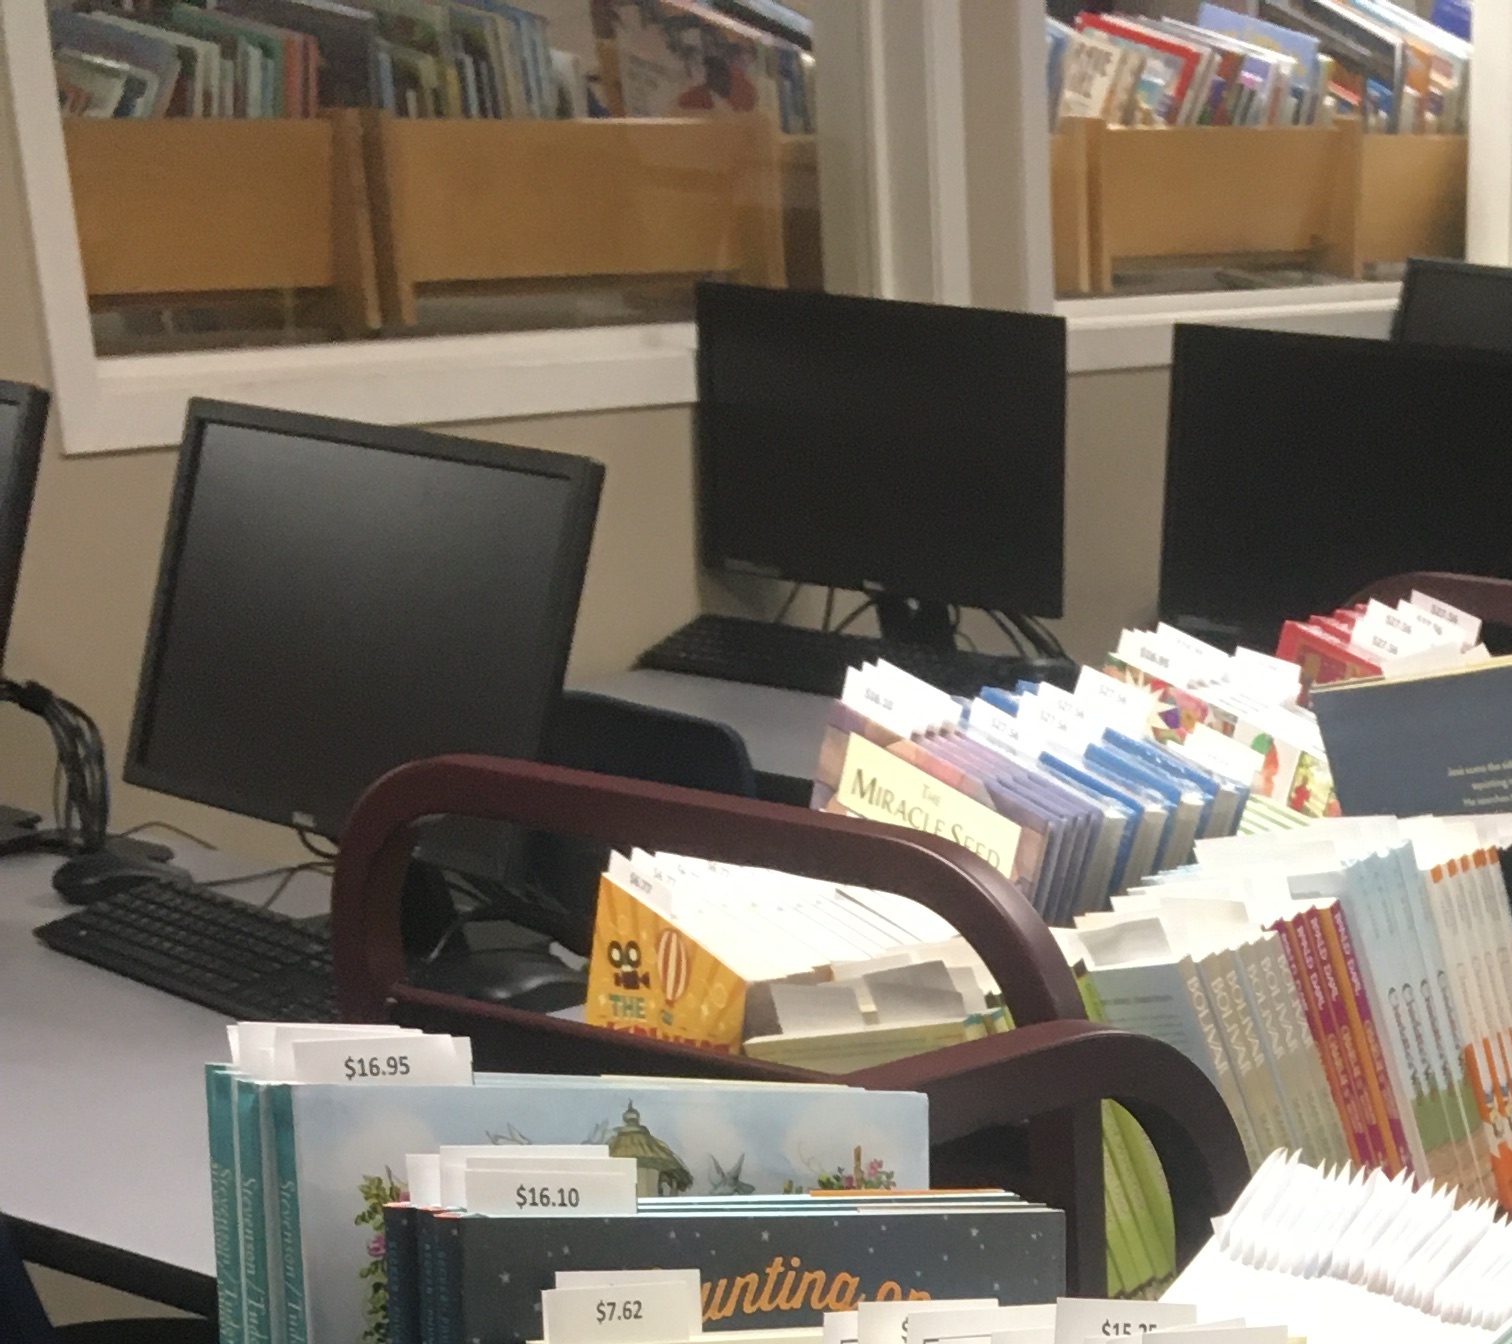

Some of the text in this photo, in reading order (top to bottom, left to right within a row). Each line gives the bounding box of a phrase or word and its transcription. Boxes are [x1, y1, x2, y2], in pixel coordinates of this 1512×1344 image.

[851, 768, 1001, 869] MIRACLE SEED
[608, 993, 646, 1019] THE
[343, 1055, 412, 1079] $16.95
[514, 1185, 580, 1212] $16.10
[701, 1256, 866, 1324] unting
[596, 1300, 643, 1322] $7.62
